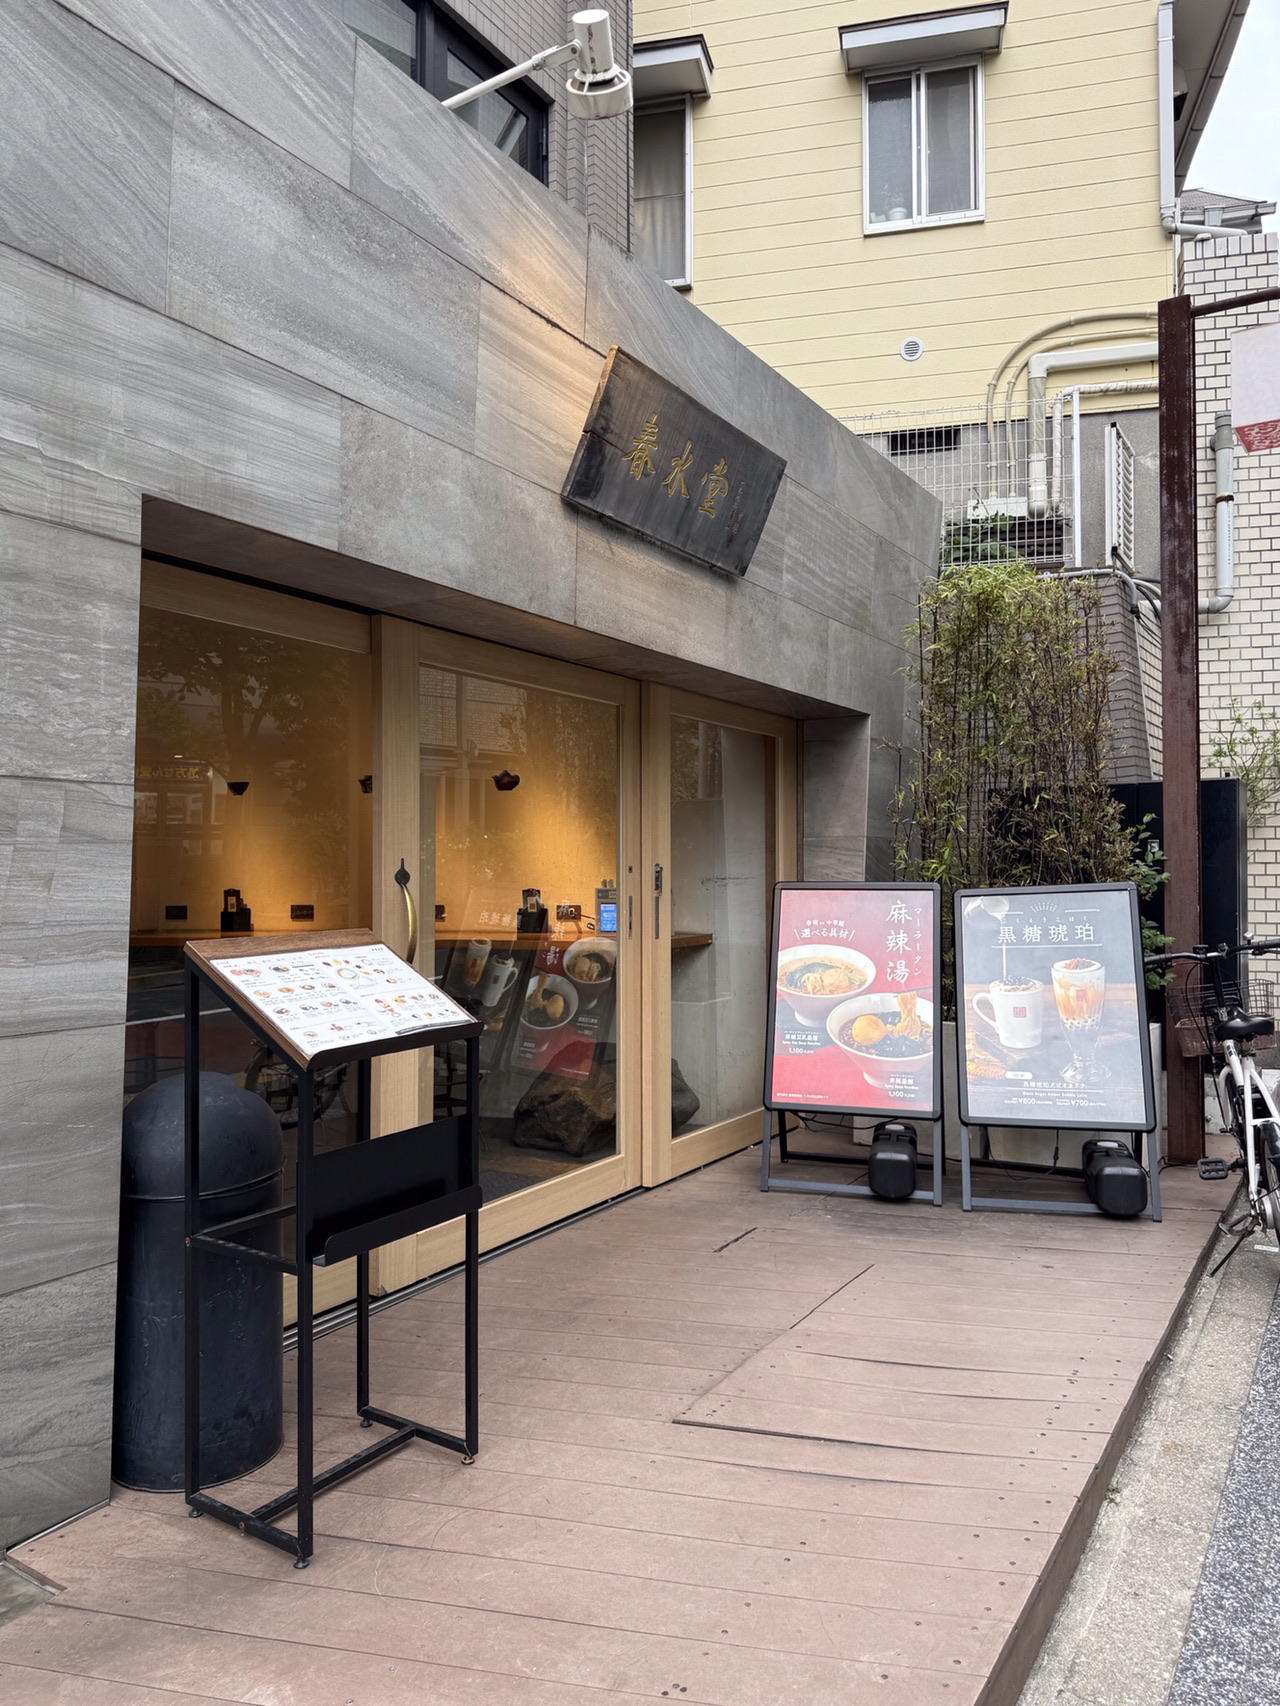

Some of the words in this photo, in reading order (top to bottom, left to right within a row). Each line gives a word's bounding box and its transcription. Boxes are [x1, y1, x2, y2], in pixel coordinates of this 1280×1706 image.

[622, 413, 729, 518] 春水堂
[801, 927, 850, 939] 選べる具材
[885, 899, 913, 985] 麻辣湯
[913, 906, 923, 977] マーラータン
[998, 923, 1094, 943] 黒糖琥珀
[1002, 915, 1088, 924] こくとうこはく
